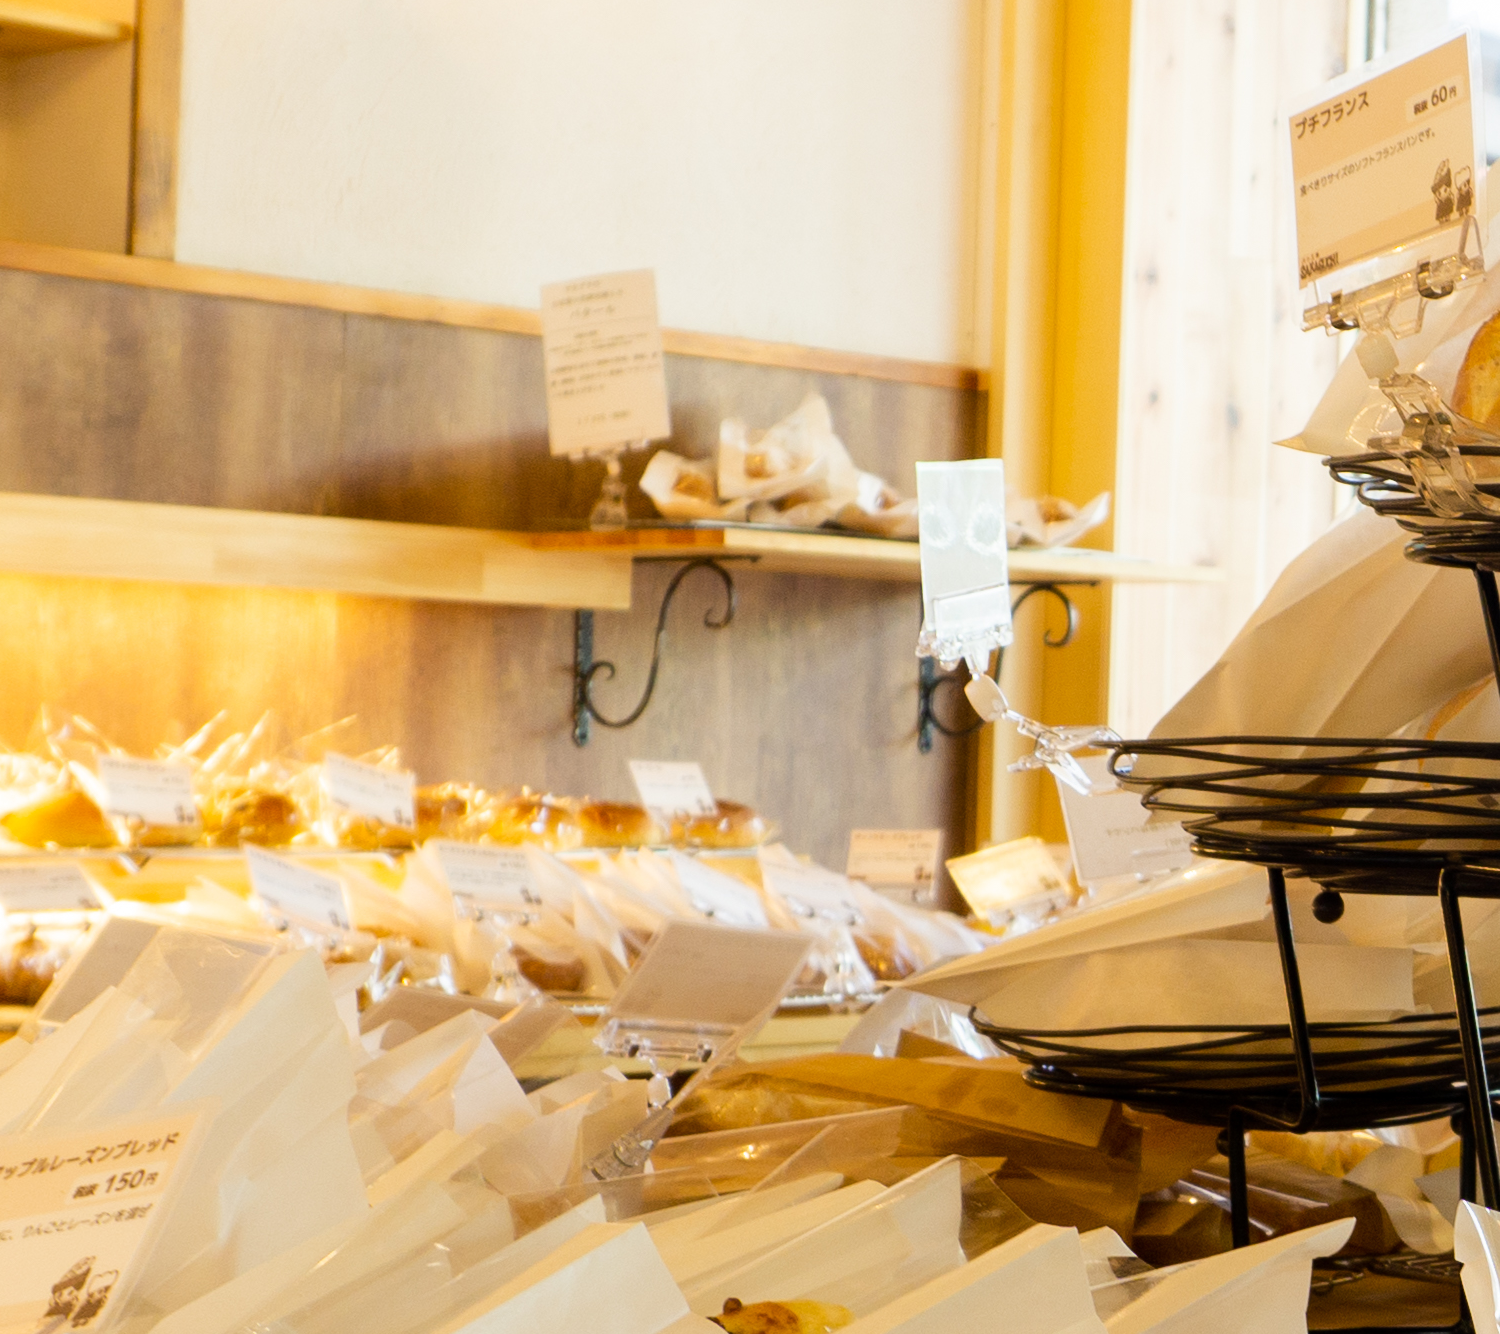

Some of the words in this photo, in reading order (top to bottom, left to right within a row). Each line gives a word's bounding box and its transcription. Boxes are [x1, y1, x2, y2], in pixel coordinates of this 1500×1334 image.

[1294, 90, 1370, 140] プチフランス
